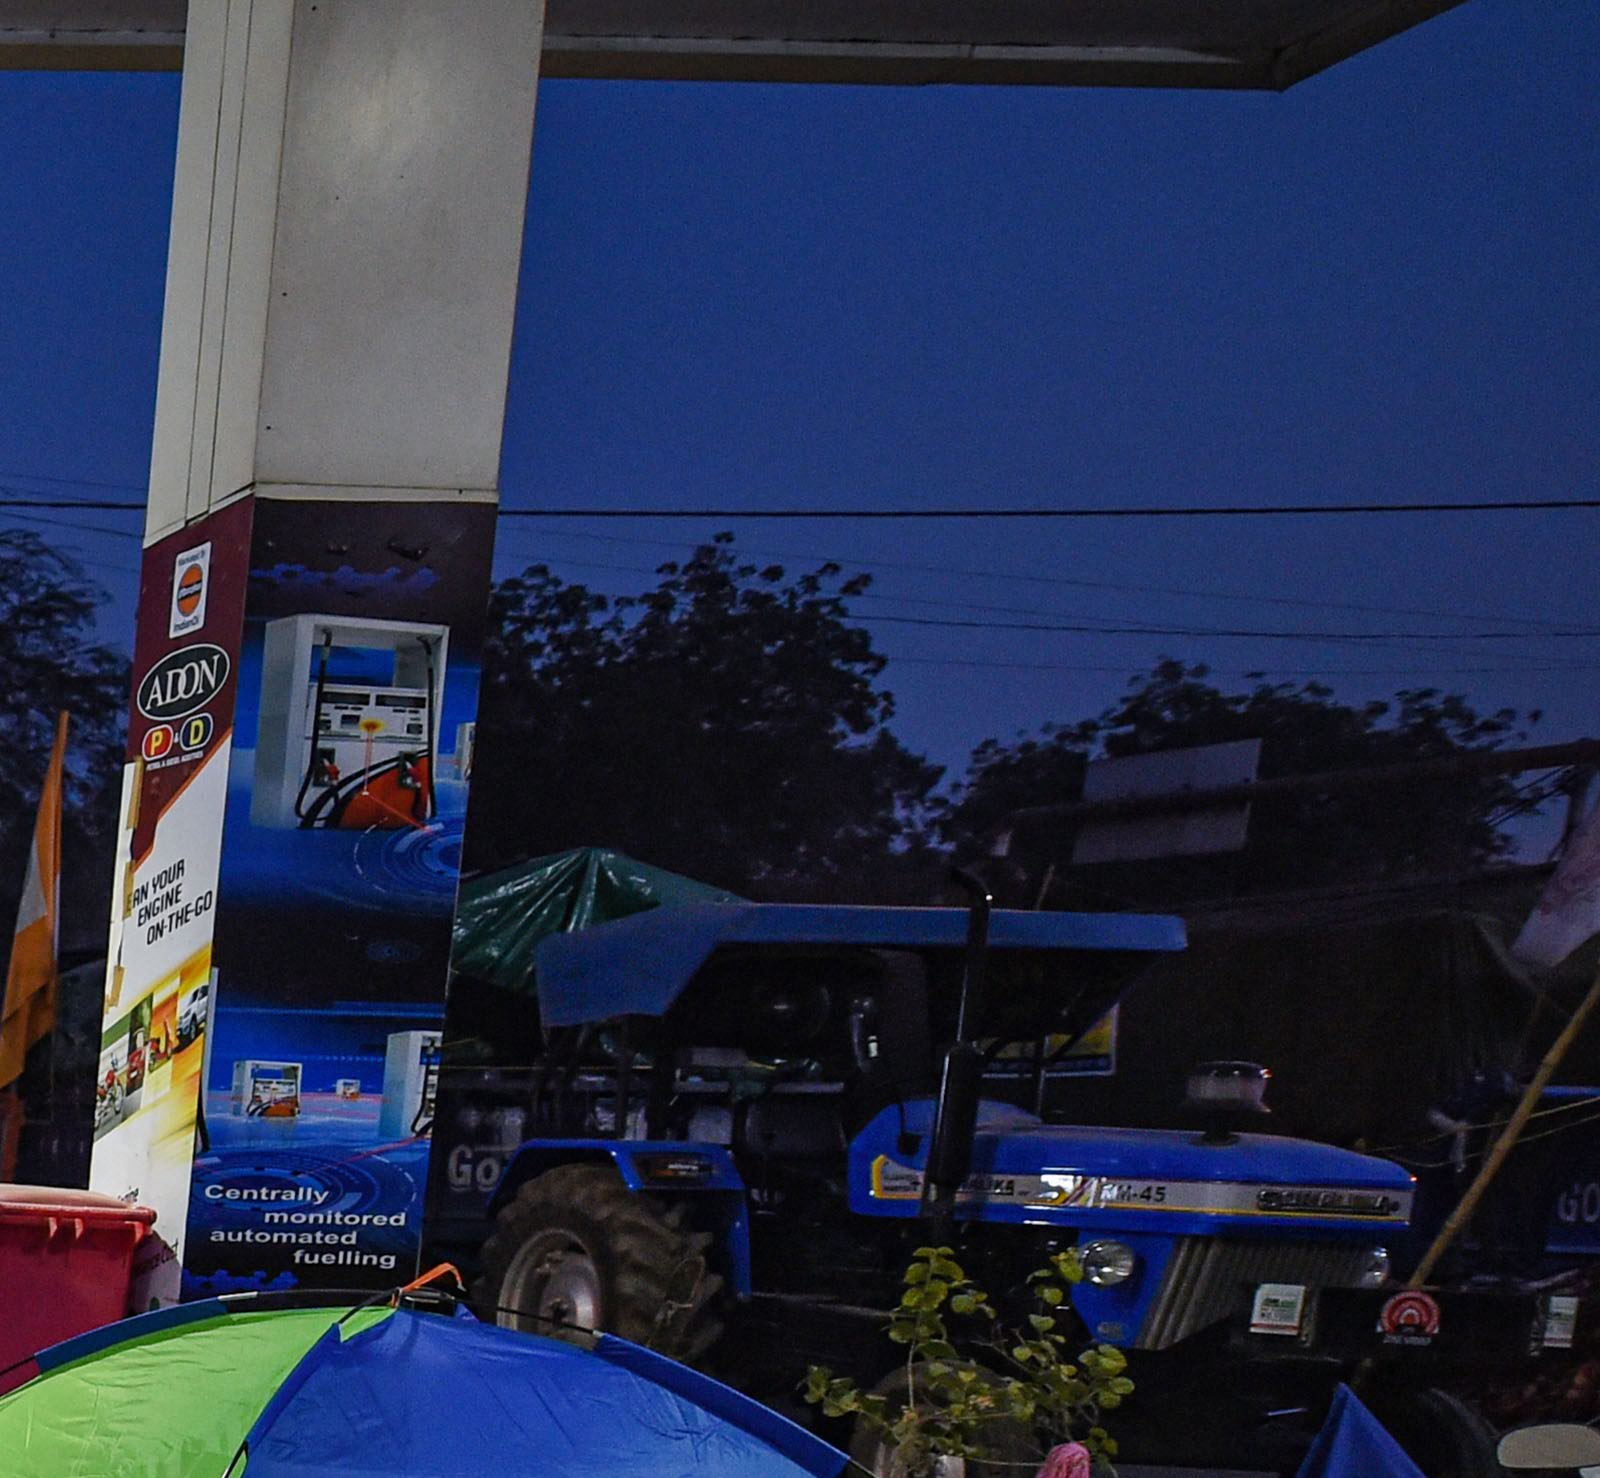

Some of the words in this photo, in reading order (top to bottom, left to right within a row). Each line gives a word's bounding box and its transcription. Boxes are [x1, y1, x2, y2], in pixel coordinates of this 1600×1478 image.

[145, 654, 220, 711] ADON
[151, 731, 163, 756] P
[190, 720, 204, 746] D
[152, 858, 185, 894] YOUR
[138, 882, 183, 927] ENGINE
[147, 890, 212, 946] ON-THE-GO
[204, 1184, 329, 1205] Centrally
[264, 1210, 406, 1226] monitored
[210, 1229, 357, 1245] automated
[293, 1249, 397, 1269] fuelling
